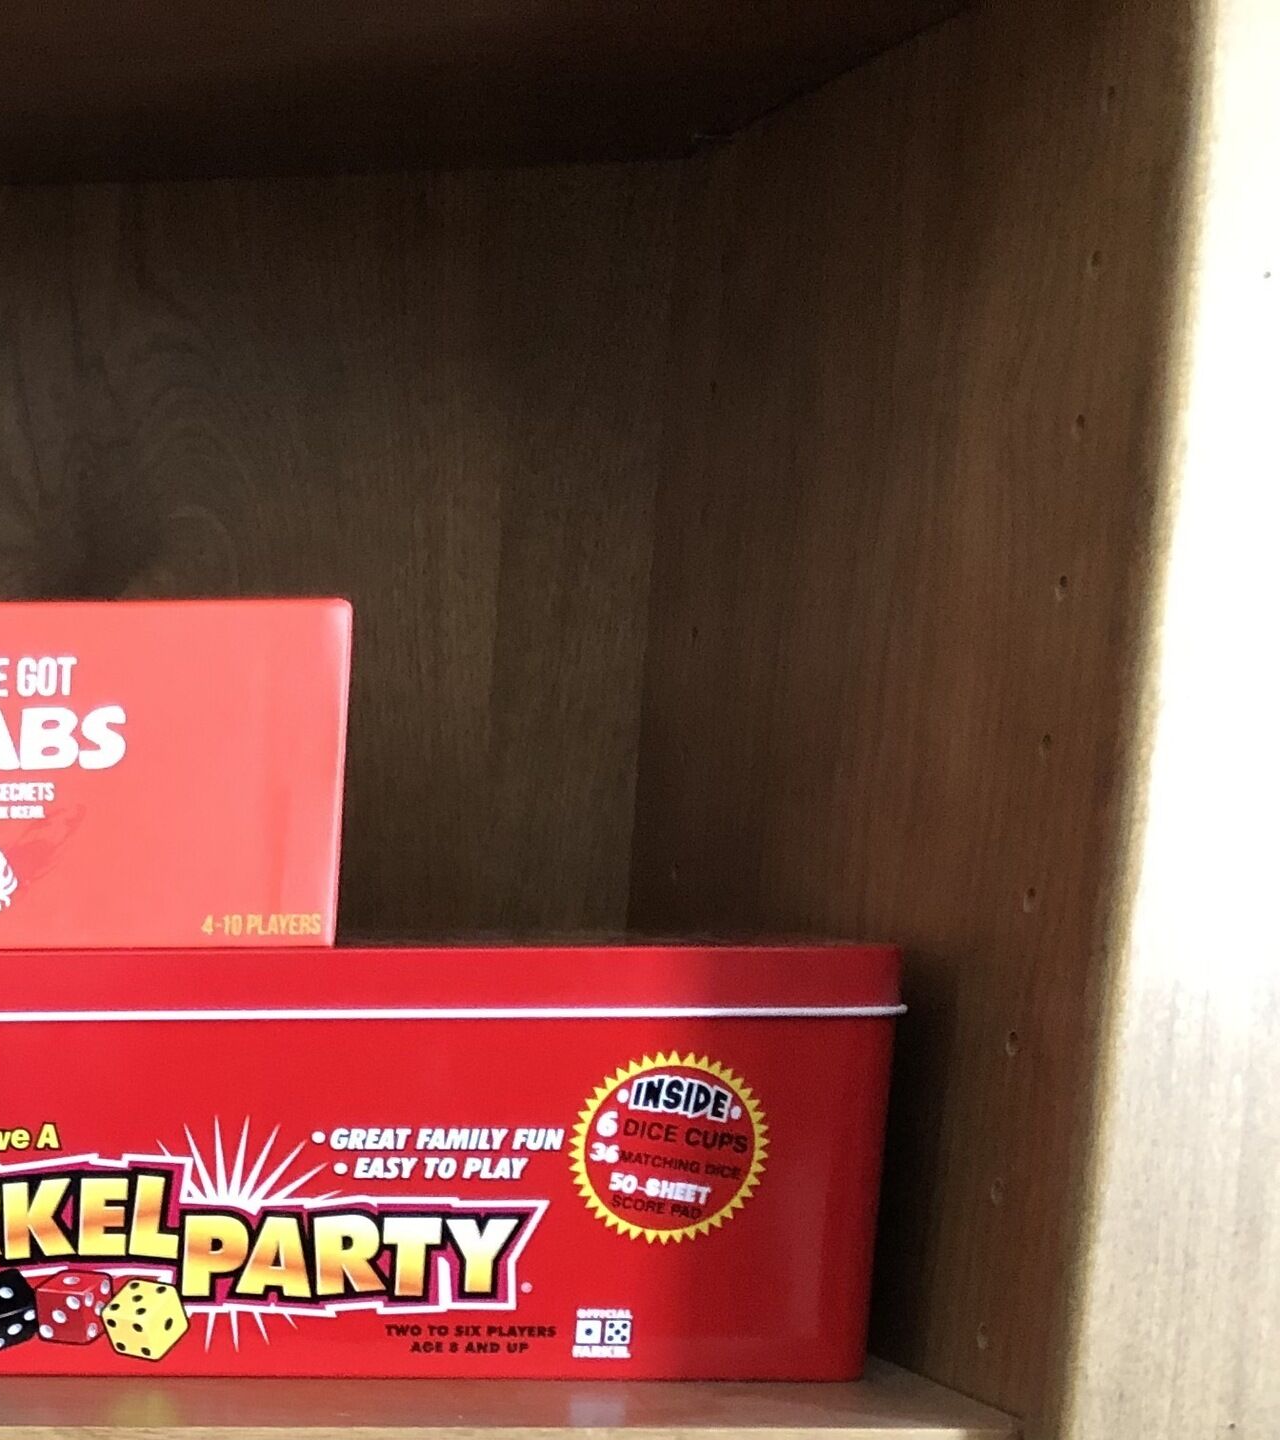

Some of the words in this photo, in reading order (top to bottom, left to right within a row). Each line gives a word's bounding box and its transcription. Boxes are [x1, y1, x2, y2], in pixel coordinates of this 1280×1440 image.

[17, 656, 77, 697] GOT
[201, 914, 243, 936] 4-10
[246, 914, 321, 936] PLAYERS
[630, 1077, 730, 1120] INSIDE
[36, 1124, 60, 1150] A
[330, 1127, 412, 1151] GREAT
[416, 1128, 508, 1151] FAMILY
[512, 1128, 565, 1151] FUN
[596, 1110, 619, 1138] 6
[623, 1118, 679, 1143] DICE
[684, 1127, 748, 1153] CUPS
[353, 1157, 419, 1179] EASY
[424, 1157, 458, 1179] TO
[462, 1157, 529, 1179] PLAY
[590, 1141, 620, 1164] 36
[620, 1150, 700, 1175] MATCHING
[704, 1162, 742, 1180] DICE
[608, 1171, 711, 1205] 50-SHEET
[611, 1194, 666, 1215] SCORE
[670, 1202, 702, 1220] PAD
[183, 1213, 519, 1298] PARTY
[386, 1324, 422, 1337] TWO
[429, 1324, 450, 1337] TO
[454, 1324, 482, 1337] SIX
[486, 1325, 557, 1338] PLAYERS
[410, 1341, 446, 1354] AGE
[464, 1342, 501, 1354] AND
[506, 1342, 529, 1354] UP
